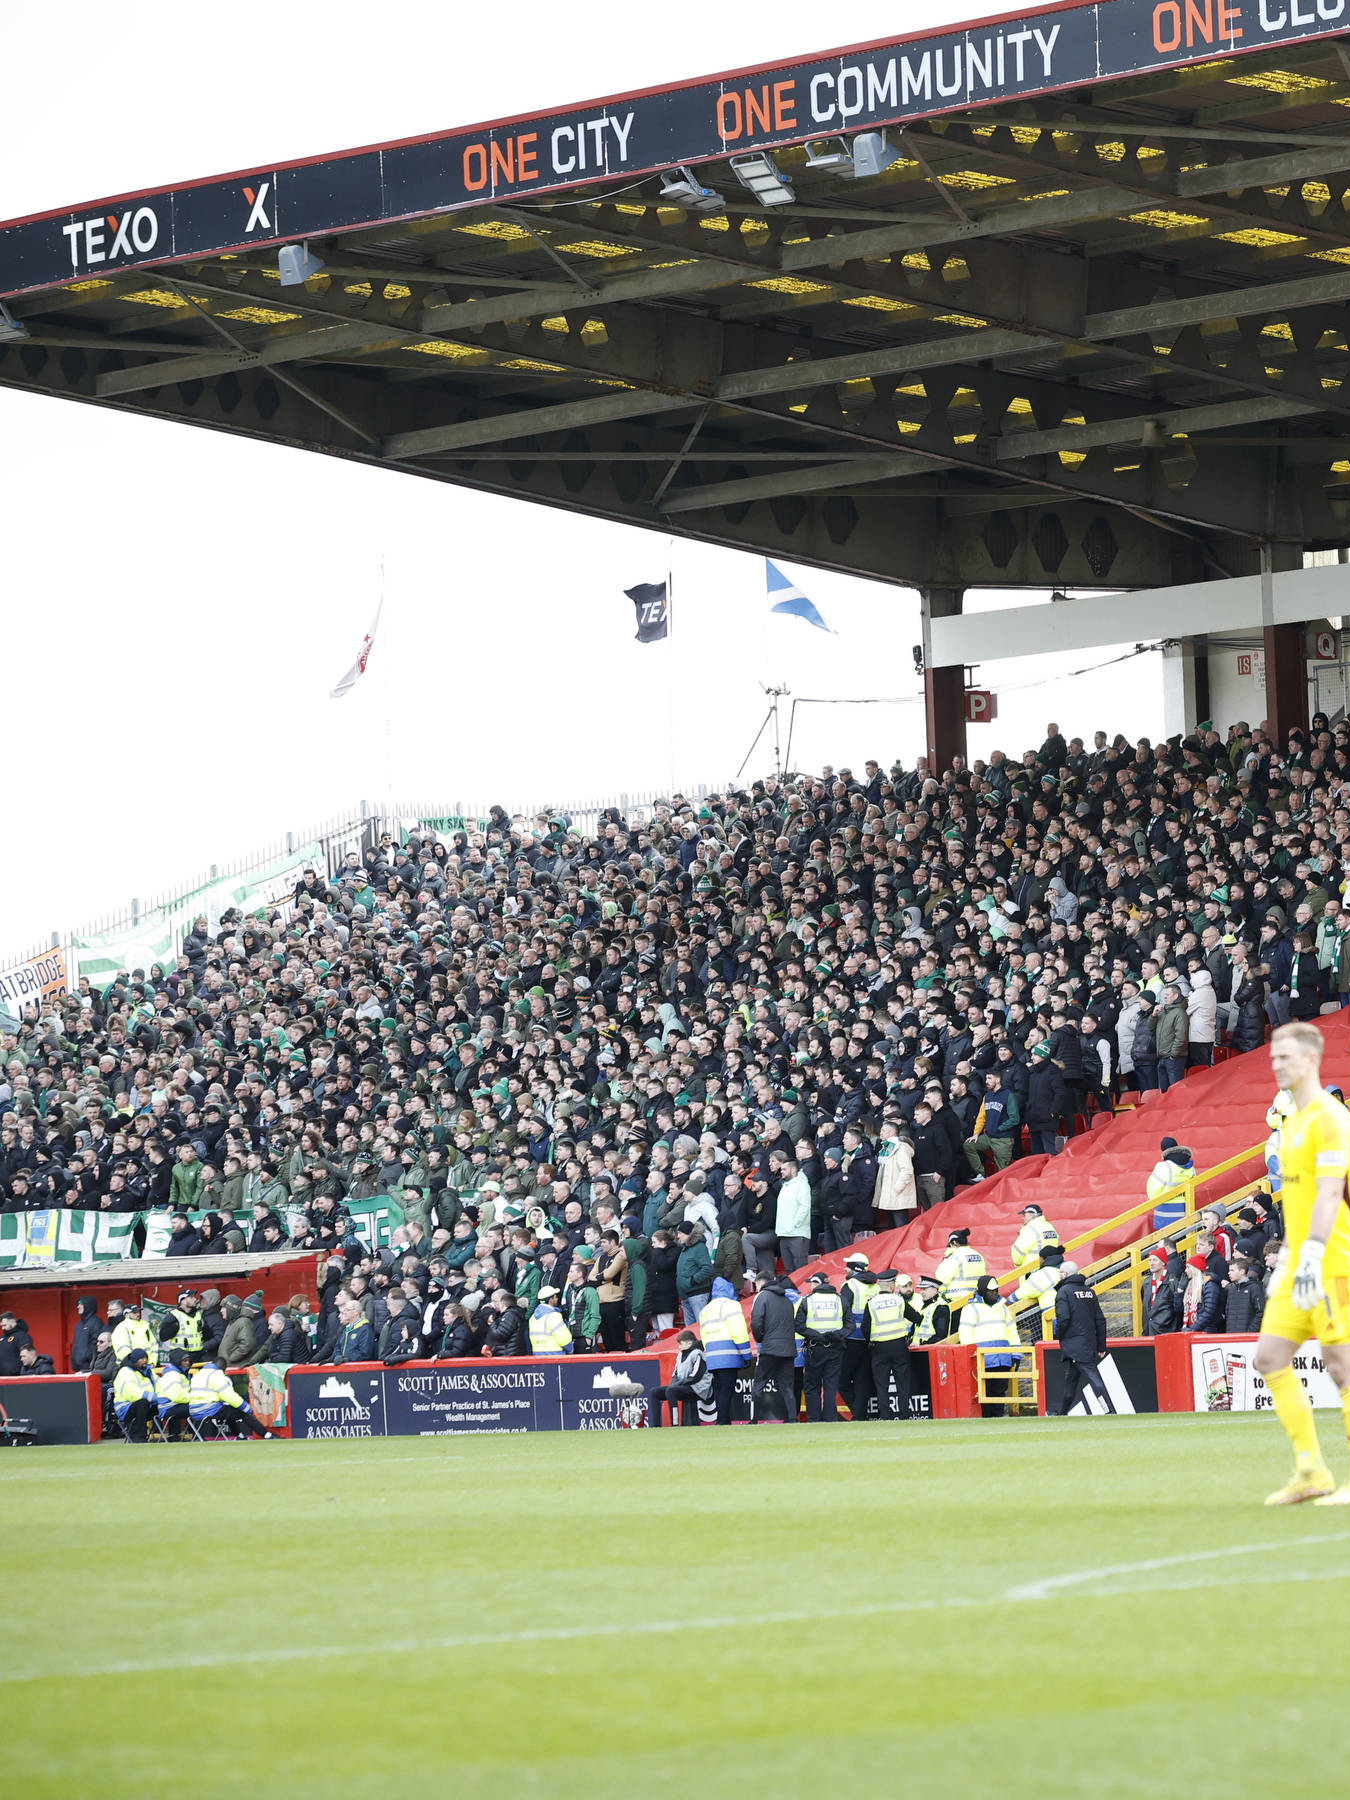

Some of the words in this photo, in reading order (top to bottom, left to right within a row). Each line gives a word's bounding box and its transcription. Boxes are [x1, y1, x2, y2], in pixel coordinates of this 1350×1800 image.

[1152, 0, 1244, 53] ONE
[715, 79, 798, 141] ONE
[809, 24, 1061, 123] COMMUNITY
[462, 132, 539, 192] ONE
[551, 112, 635, 175] CITY
[62, 206, 159, 268] TEXO
[1317, 632, 1336, 659] Q
[970, 695, 987, 719] P
[1074, 1291, 1094, 1299] TEXO
[875, 1299, 897, 1309] POLICE
[1311, 1357, 1328, 1373] Ap
[398, 1376, 434, 1392] SCOTT
[1253, 1377, 1264, 1388] to
[412, 1402, 430, 1412] Senior
[431, 1401, 451, 1411] Partner
[452, 1401, 475, 1410] Practice
[475, 1400, 481, 1409] of
[515, 1399, 530, 1408] Place
[579, 1398, 613, 1413] SCOTT
[1254, 1394, 1273, 1410] gre
[306, 1407, 338, 1422] SCOTT
[340, 1406, 371, 1425] JAMES
[445, 1413, 465, 1422] Wealth
[465, 1412, 500, 1422] Management
